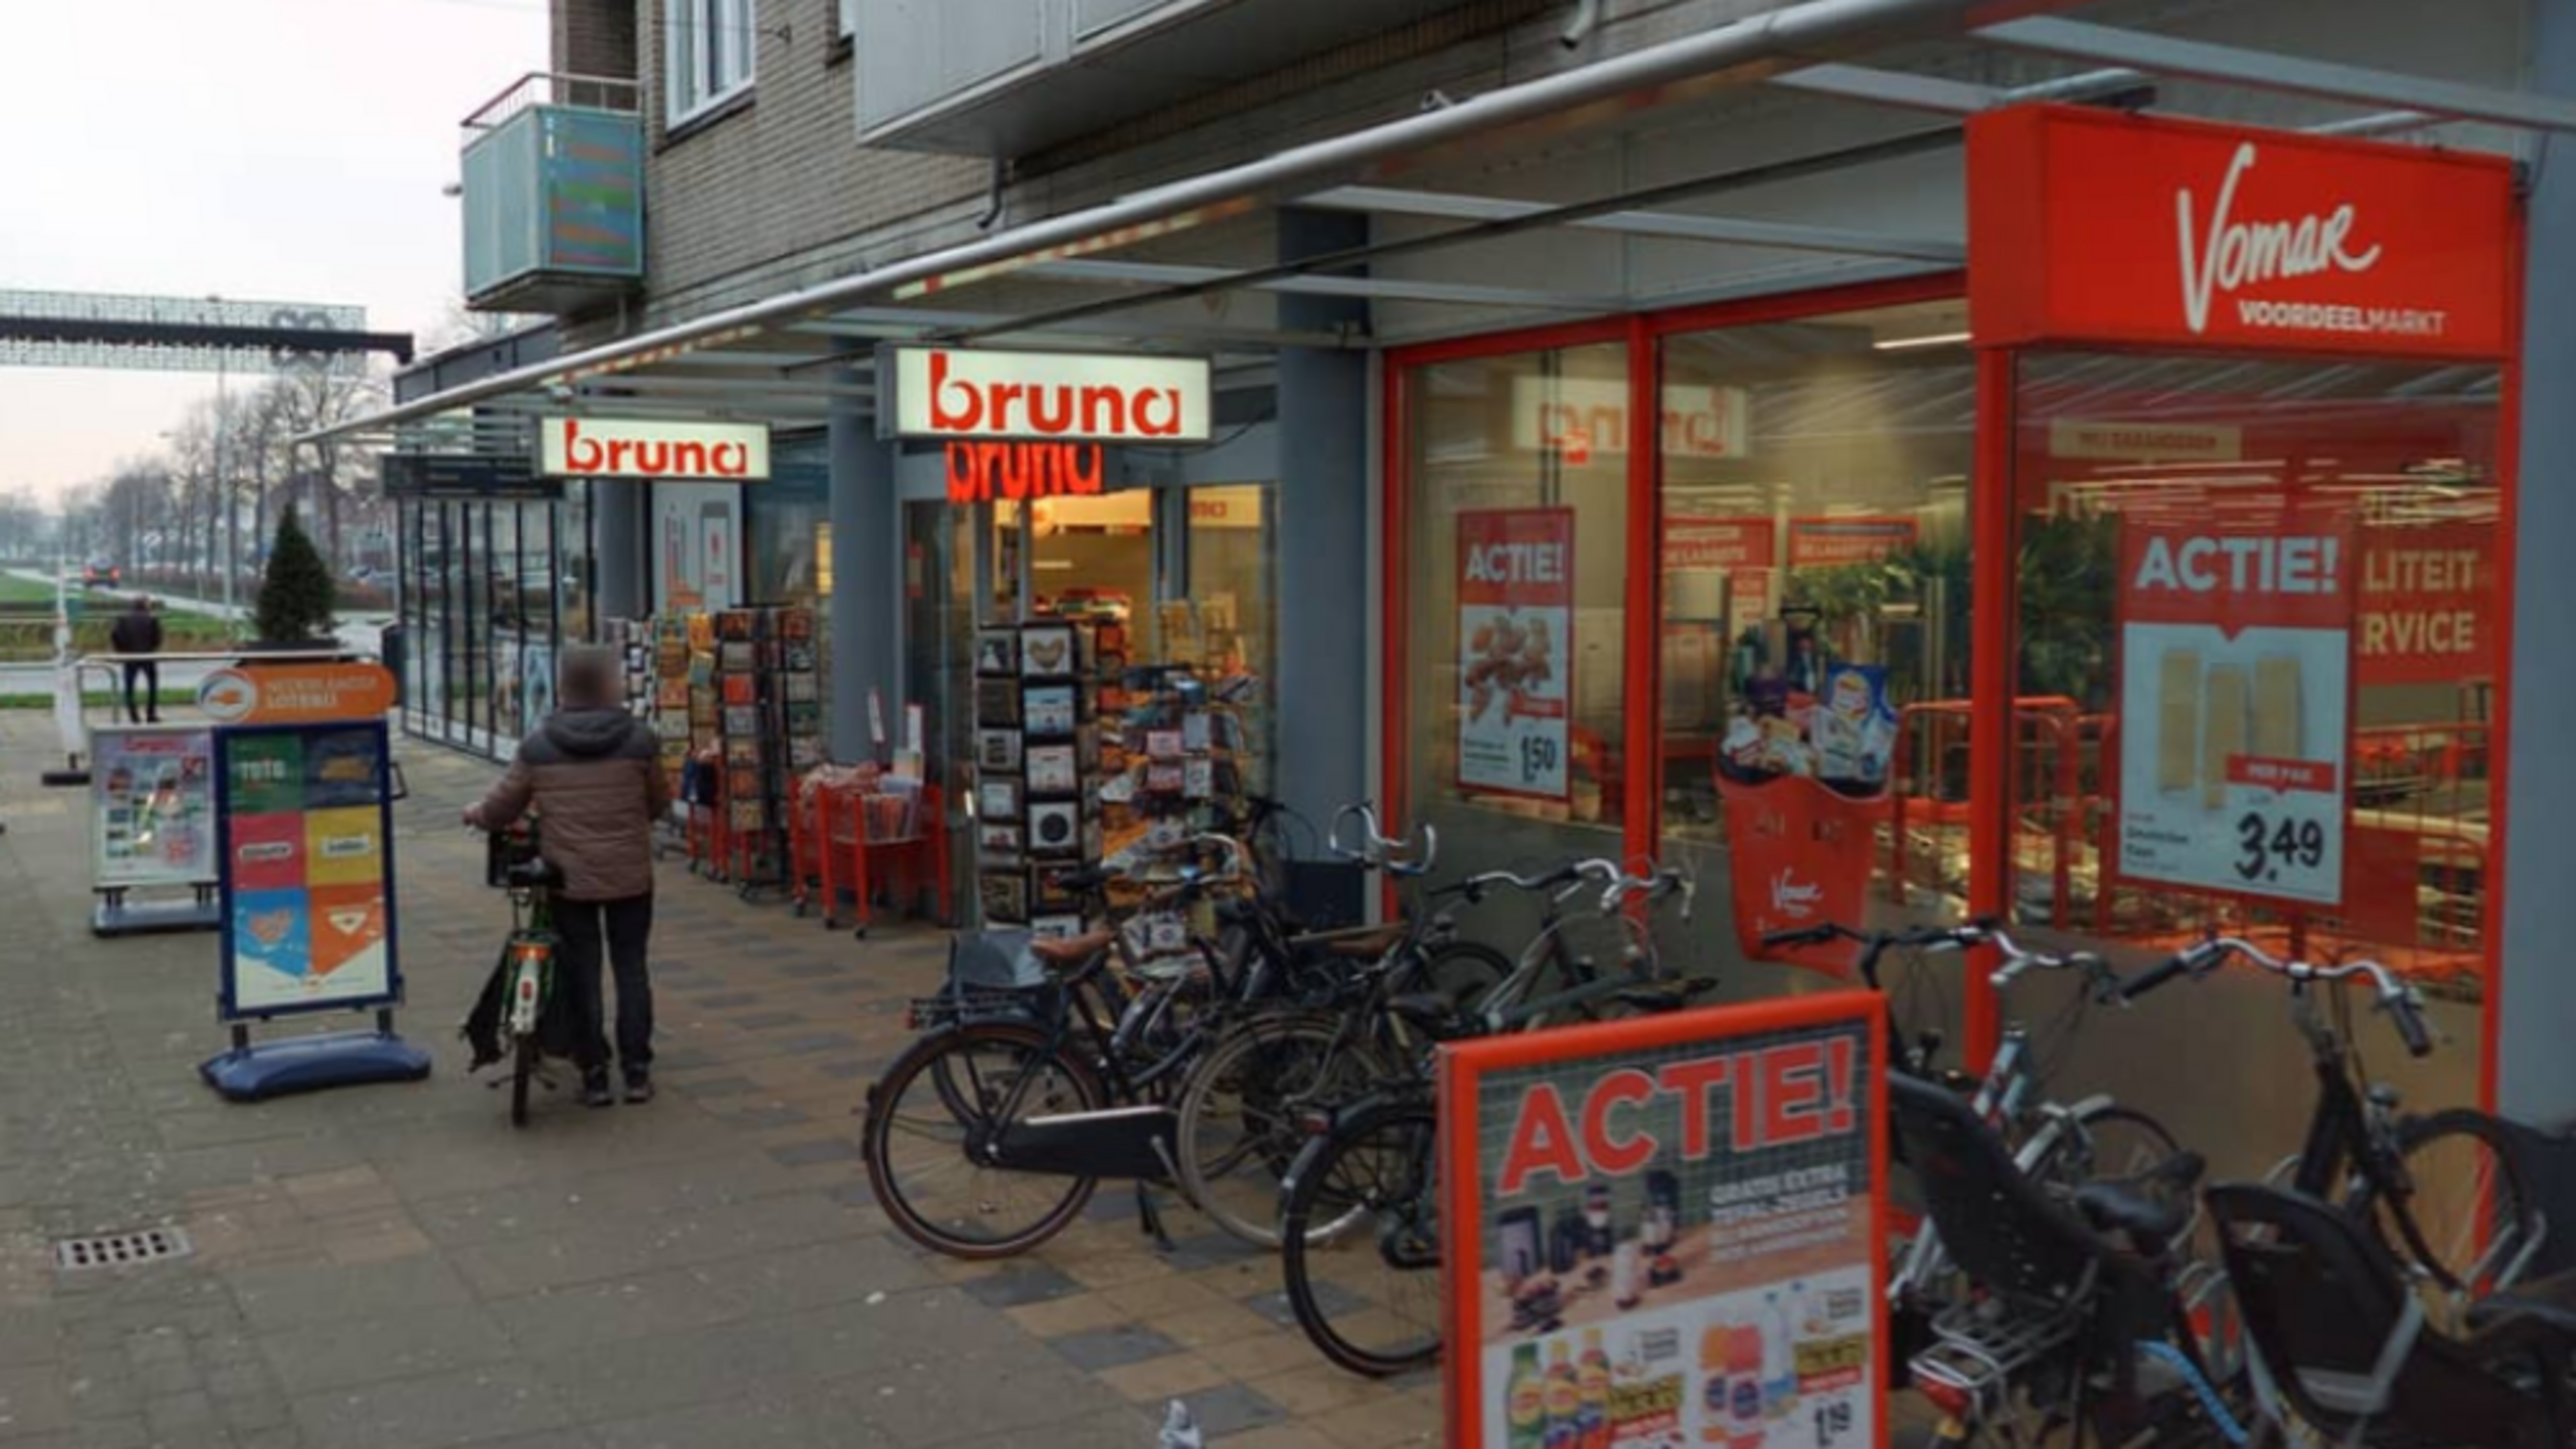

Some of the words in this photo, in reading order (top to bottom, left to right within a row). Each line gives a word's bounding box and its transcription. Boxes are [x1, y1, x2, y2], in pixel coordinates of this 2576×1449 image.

[2176, 142, 2382, 333] Vomar
[2239, 299, 2447, 335] VOORDEELMARKT
[928, 351, 1181, 435] bruna
[565, 419, 748, 475] bruna
[1465, 541, 1566, 582] ACTIE!
[2134, 535, 2340, 594] ACTIE!
[2363, 549, 2480, 592] LITEIT
[1495, 1036, 1856, 1197] ACTIE!
